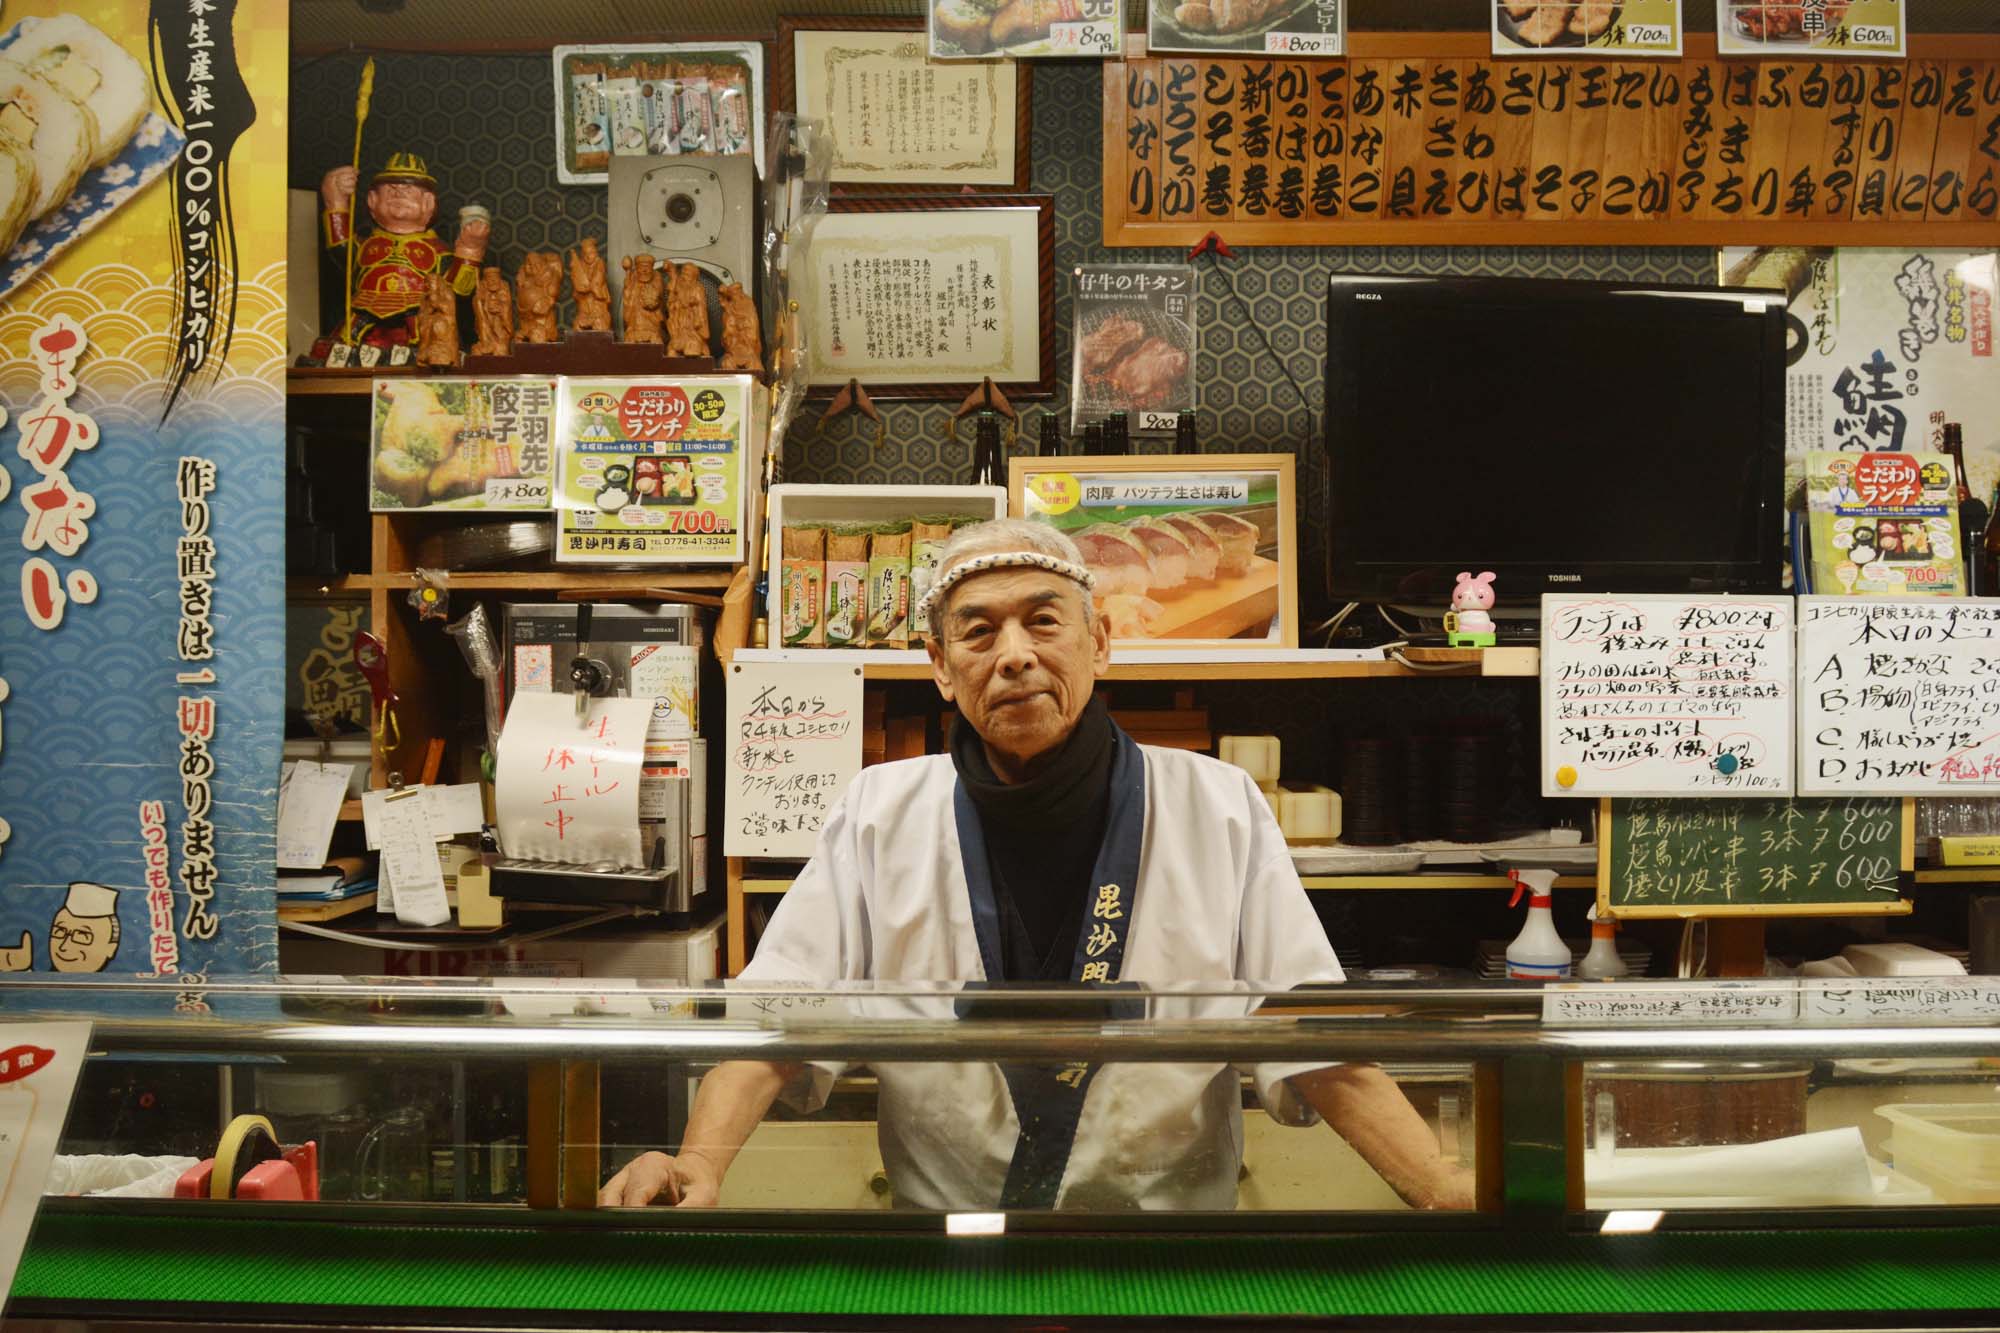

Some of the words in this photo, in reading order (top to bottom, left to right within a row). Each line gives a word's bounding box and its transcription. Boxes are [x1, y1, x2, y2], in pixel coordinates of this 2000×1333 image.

[1080, 25, 1112, 45] 800
[1289, 37, 1321, 51] 800
[1127, 68, 1159, 215] いなり
[1201, 64, 1236, 216] しそ巻
[1236, 62, 1273, 216] 新香巻
[1347, 65, 1386, 213] あなご
[1387, 64, 1423, 217] 赤貝
[1456, 62, 1497, 214] あわび
[1493, 67, 1535, 215] さば
[1531, 64, 1574, 212] げそ
[1567, 65, 1608, 214] 玉子
[1602, 65, 1647, 215] たこ
[1638, 64, 1680, 214] いか
[1711, 65, 1757, 213] はまち
[1751, 65, 1796, 215] ぶり
[1857, 65, 1902, 216] とり貝
[1891, 62, 1942, 214] かに
[1931, 66, 1976, 216] えび
[981, 273, 998, 332] 表彰状
[1080, 273, 1186, 291] 仔牛の牛タン
[1355, 293, 1382, 301] REGZA
[491, 385, 521, 444] 餃子
[520, 387, 550, 472] 手羽先
[624, 399, 686, 417] こだわり
[626, 419, 683, 440] ランチ
[1146, 414, 1174, 428] 900
[515, 483, 548, 498] 800
[1086, 487, 1115, 501] 肉厚
[1124, 485, 1242, 501] バッテラ生さば寿し
[1858, 466, 1916, 484] こだわり
[1862, 485, 1916, 504] ランチ
[569, 536, 646, 551] 毘沙門寿司
[669, 510, 731, 534] 700円
[1548, 574, 1581, 582] TOSHIBA
[177, 457, 219, 940] 作り置きは一切ありません
[1813, 653, 1844, 684] A
[542, 748, 579, 841] 休止中
[741, 812, 826, 838] ご賞味下さ
[140, 802, 177, 976] いつでも作りたて
